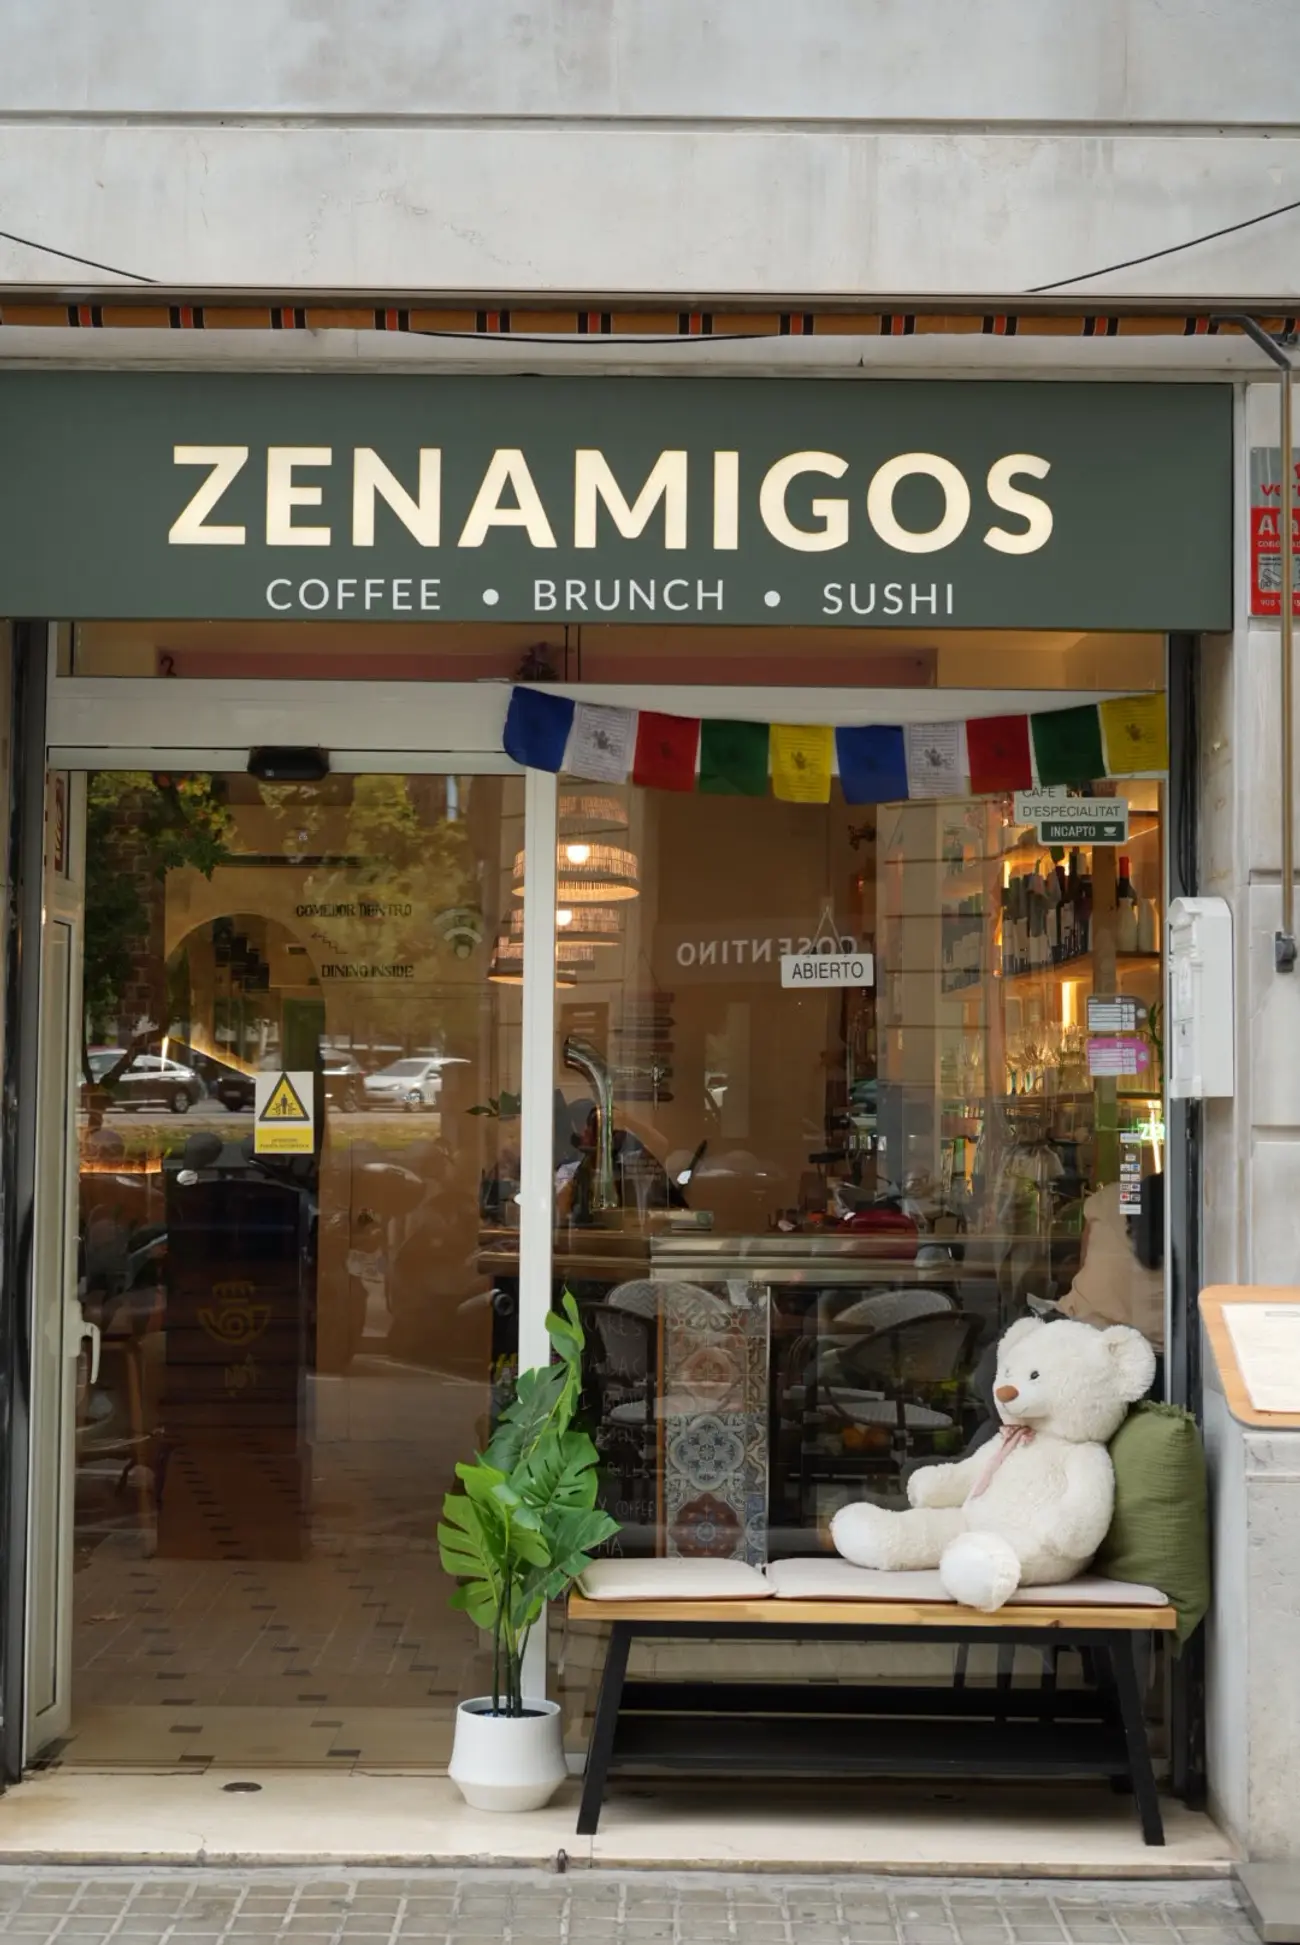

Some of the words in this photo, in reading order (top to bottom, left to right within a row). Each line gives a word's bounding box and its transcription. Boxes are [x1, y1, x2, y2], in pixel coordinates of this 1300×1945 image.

[168, 445, 1055, 555] ZENAMIGOS
[266, 578, 442, 611] COFFEE
[534, 579, 724, 612] BRUNCH
[822, 583, 953, 615] SUSHI
[1022, 805, 1121, 817] D'ESPECIALITAT
[1050, 826, 1096, 837] INCAPTO
[792, 961, 864, 980] ABIERTO
